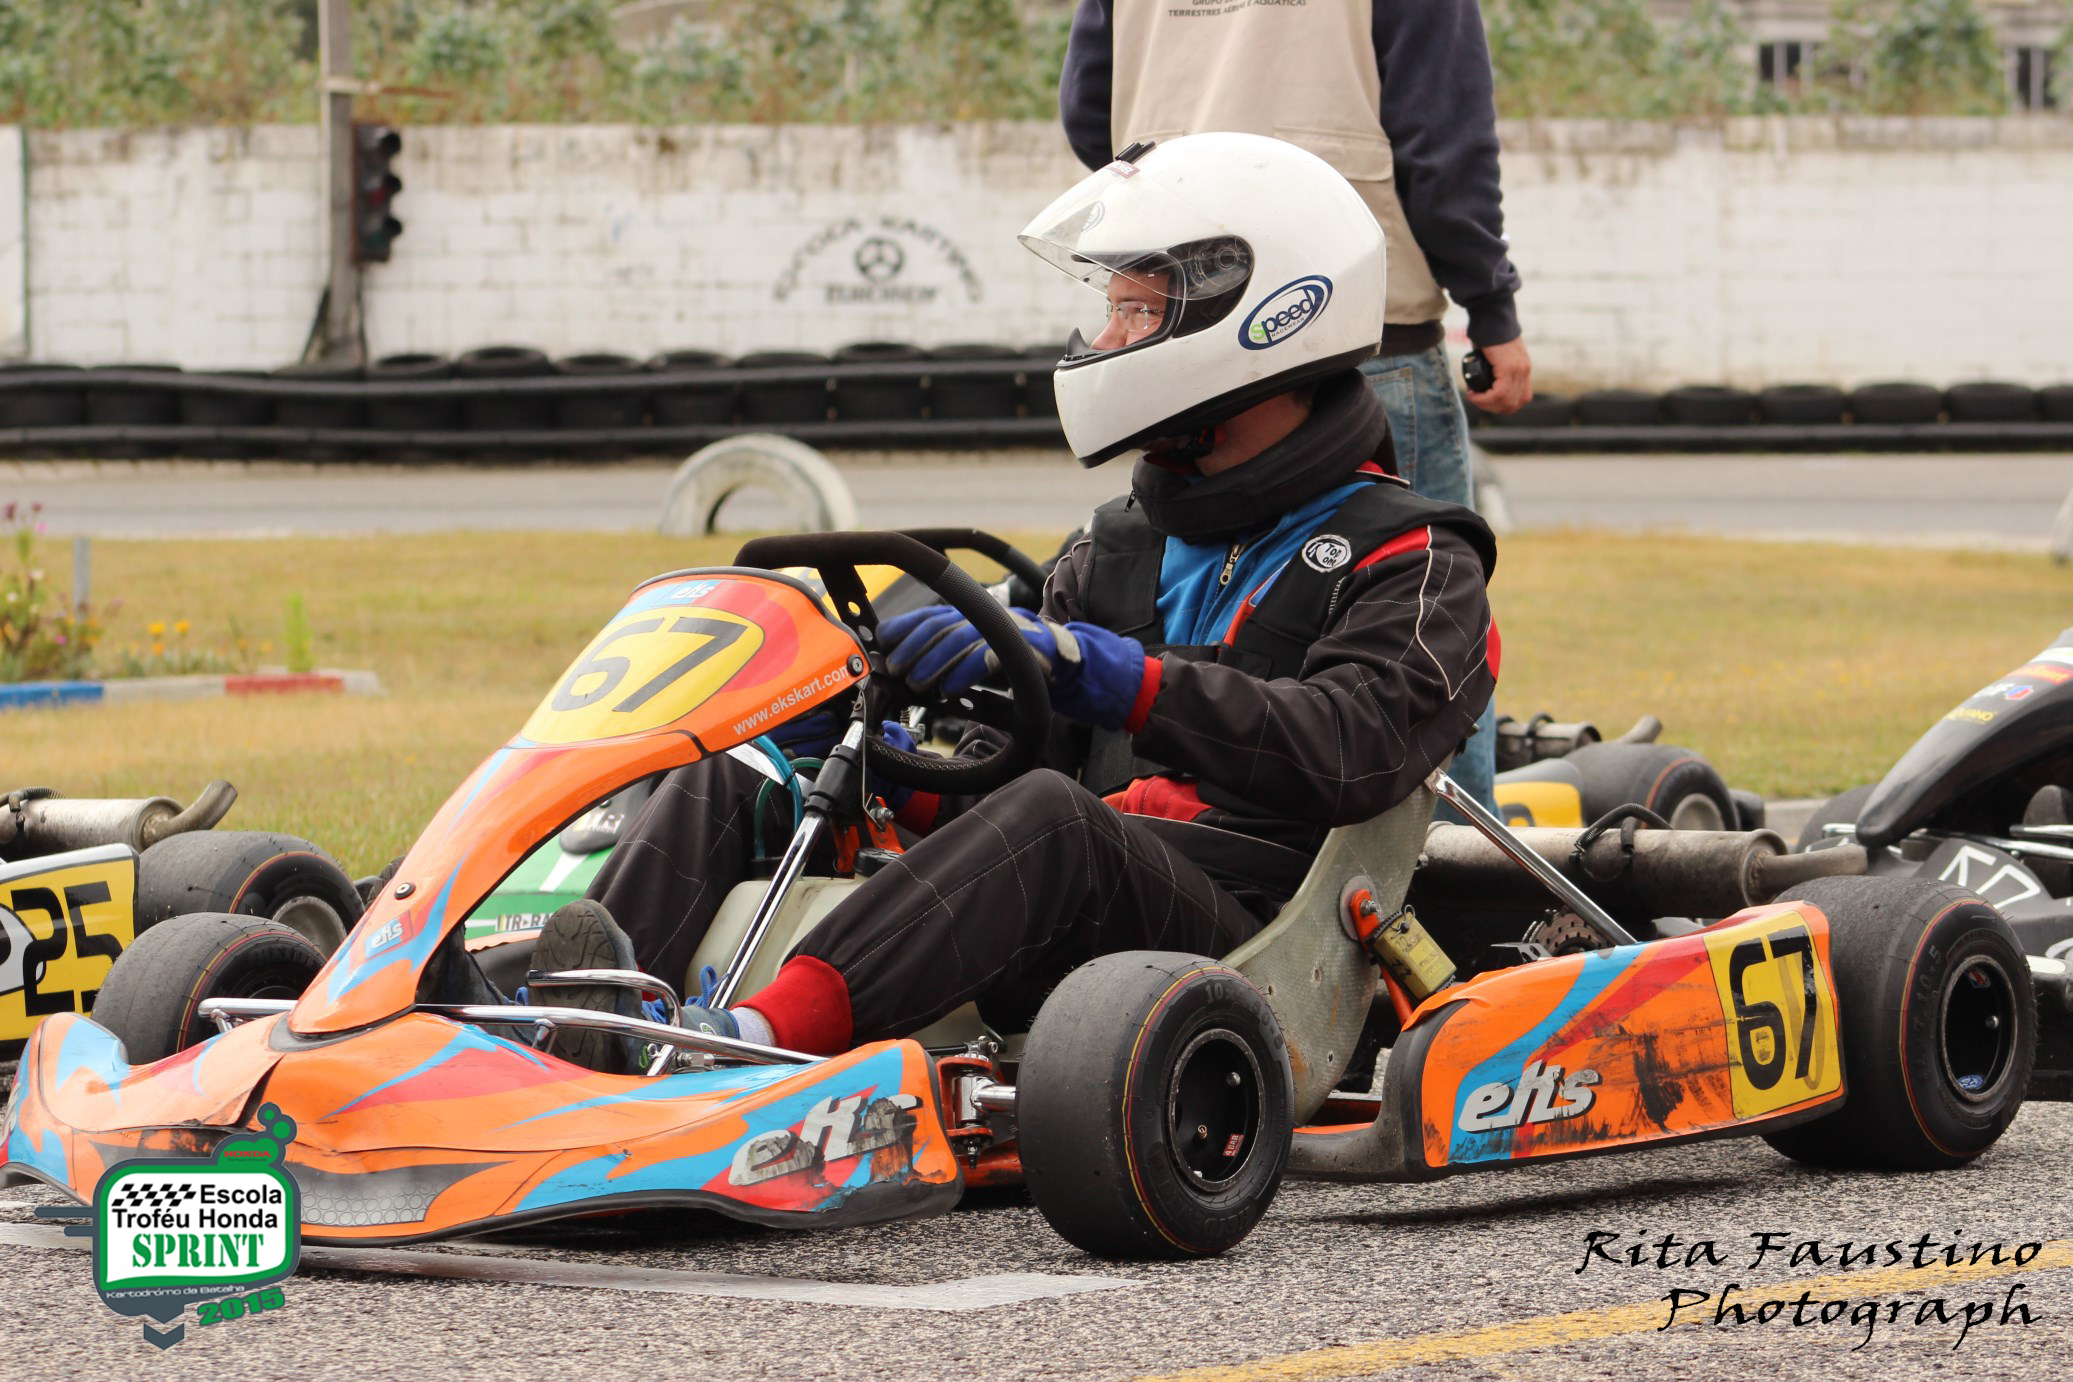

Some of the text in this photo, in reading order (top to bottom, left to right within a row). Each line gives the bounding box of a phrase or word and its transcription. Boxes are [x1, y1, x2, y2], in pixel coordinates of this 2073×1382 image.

[1168, 9, 1221, 17] TERRESTRES
[1249, 288, 1314, 343] speed
[1271, 316, 1306, 338] RACEWEAR
[551, 616, 749, 713] 67
[733, 664, 850, 737] www.ekskart.com
[10, 880, 124, 1018] 25
[1728, 924, 1818, 1091] 67
